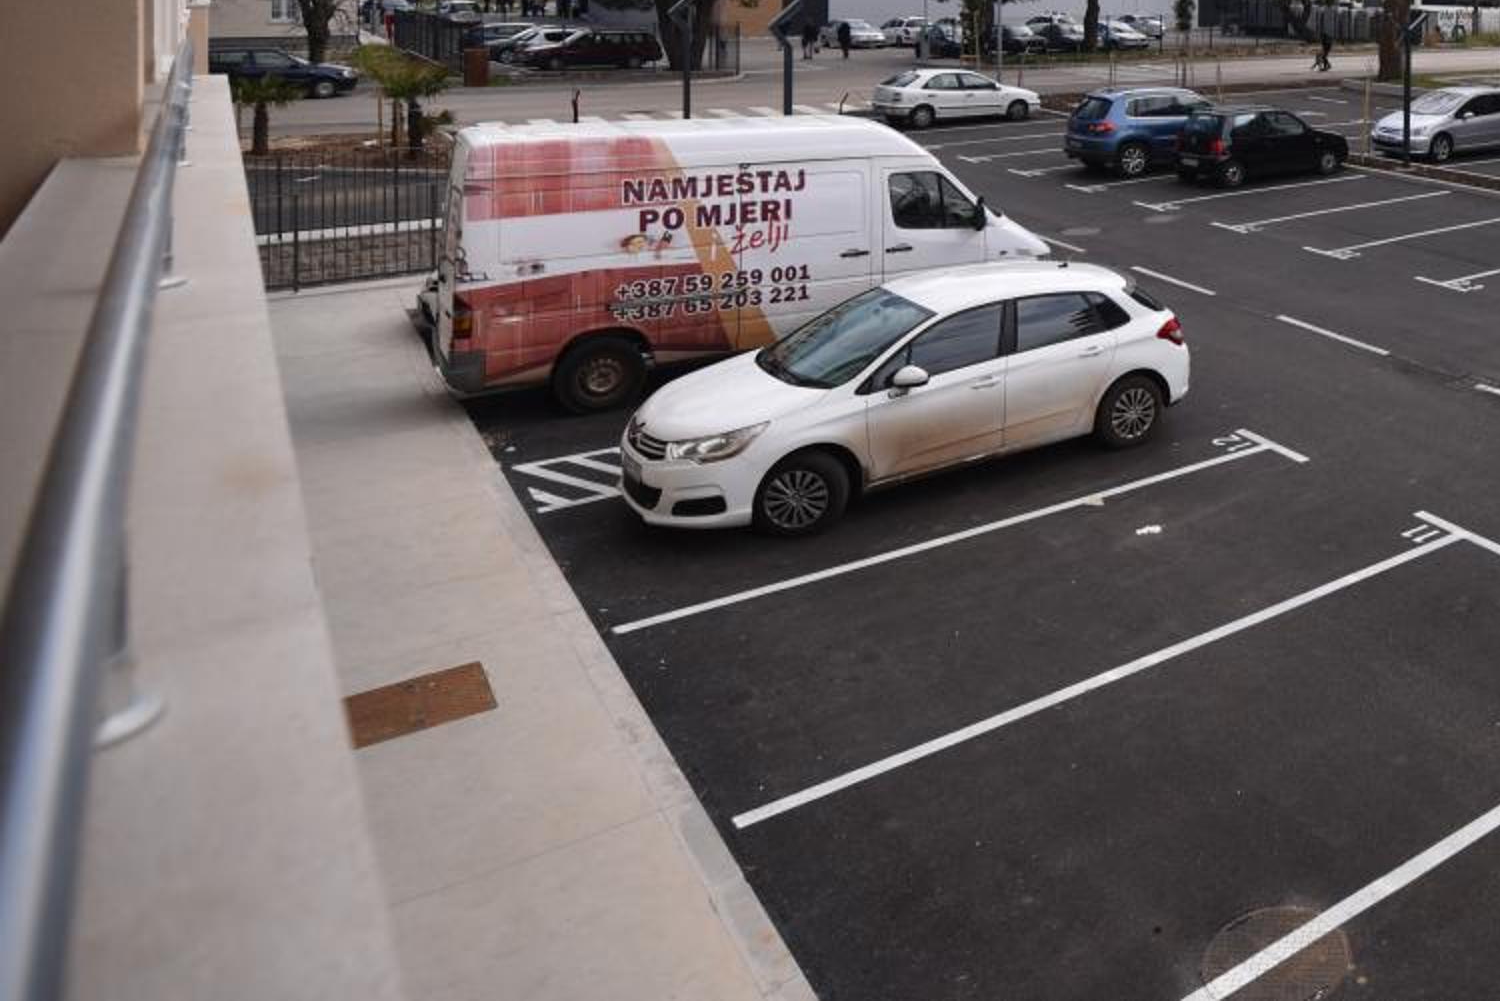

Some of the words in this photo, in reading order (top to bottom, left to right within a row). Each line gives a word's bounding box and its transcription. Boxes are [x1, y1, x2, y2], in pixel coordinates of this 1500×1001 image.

[623, 163, 806, 204] NAMJEŠTAJ
[639, 207, 685, 233] PO
[696, 198, 792, 228] MJERI
[730, 215, 789, 255] želji
[617, 278, 677, 300] +387
[685, 274, 713, 293] 59
[721, 269, 763, 288] 259
[770, 264, 811, 283] 001
[720, 290, 763, 310] 203
[769, 285, 811, 304] 221
